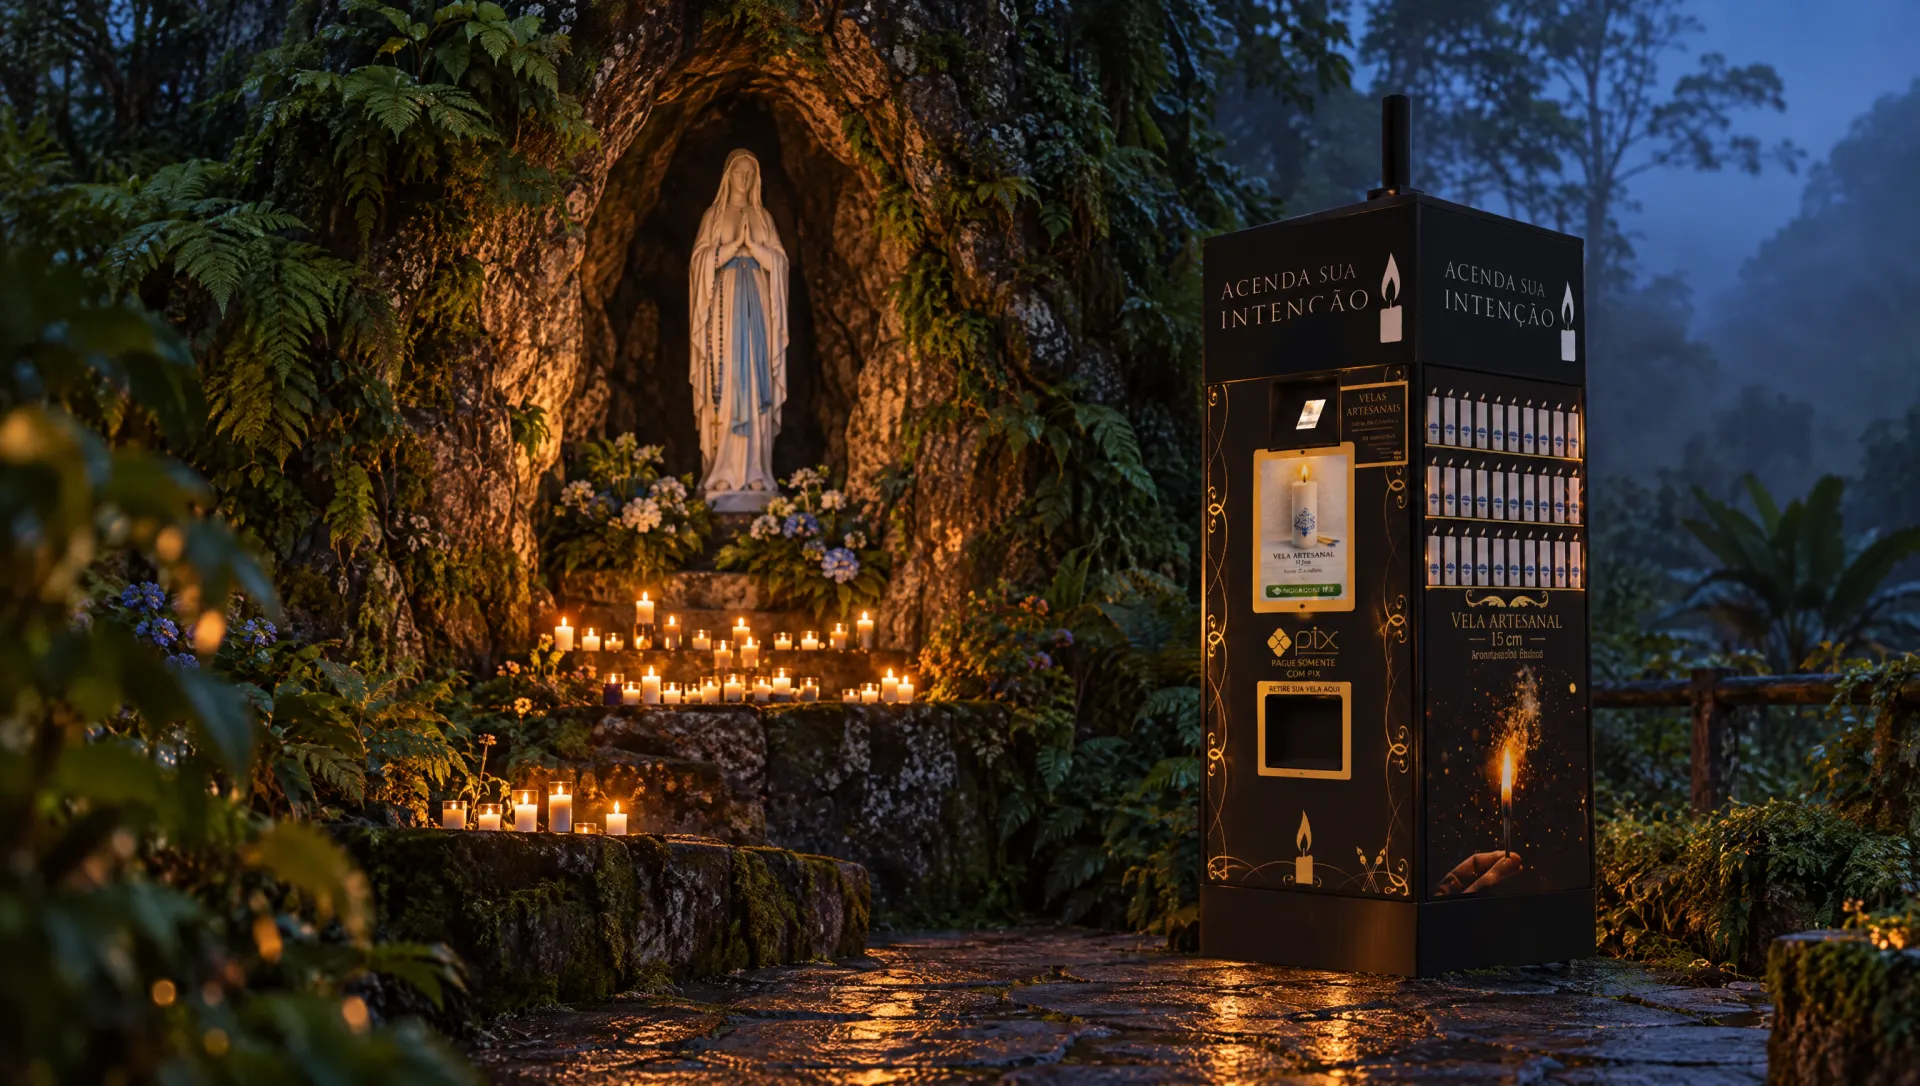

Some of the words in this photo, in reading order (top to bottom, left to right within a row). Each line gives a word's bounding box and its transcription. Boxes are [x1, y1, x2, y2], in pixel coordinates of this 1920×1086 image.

[1221, 269, 1310, 300] ACENDA
[1319, 263, 1357, 283] SUA
[1444, 261, 1516, 292] ACENDA
[1520, 278, 1546, 298] SUA
[1445, 289, 1554, 328] INTENÇÃO
[1359, 392, 1387, 403] VELAS
[1346, 403, 1401, 417] ARTESANAIS
[1293, 551, 1335, 559] ARTESANAL
[1451, 612, 1486, 629] VELA
[1489, 613, 1562, 629] ARTESANAL
[1295, 625, 1339, 656] pix
[1491, 631, 1504, 646] 15
[1505, 634, 1523, 646] cm
[1271, 659, 1296, 667] PAGUE
[1297, 658, 1336, 667] SOMENTE
[1286, 669, 1305, 678] COM
[1307, 670, 1321, 678] PIX
[1323, 685, 1340, 693] AQUI
